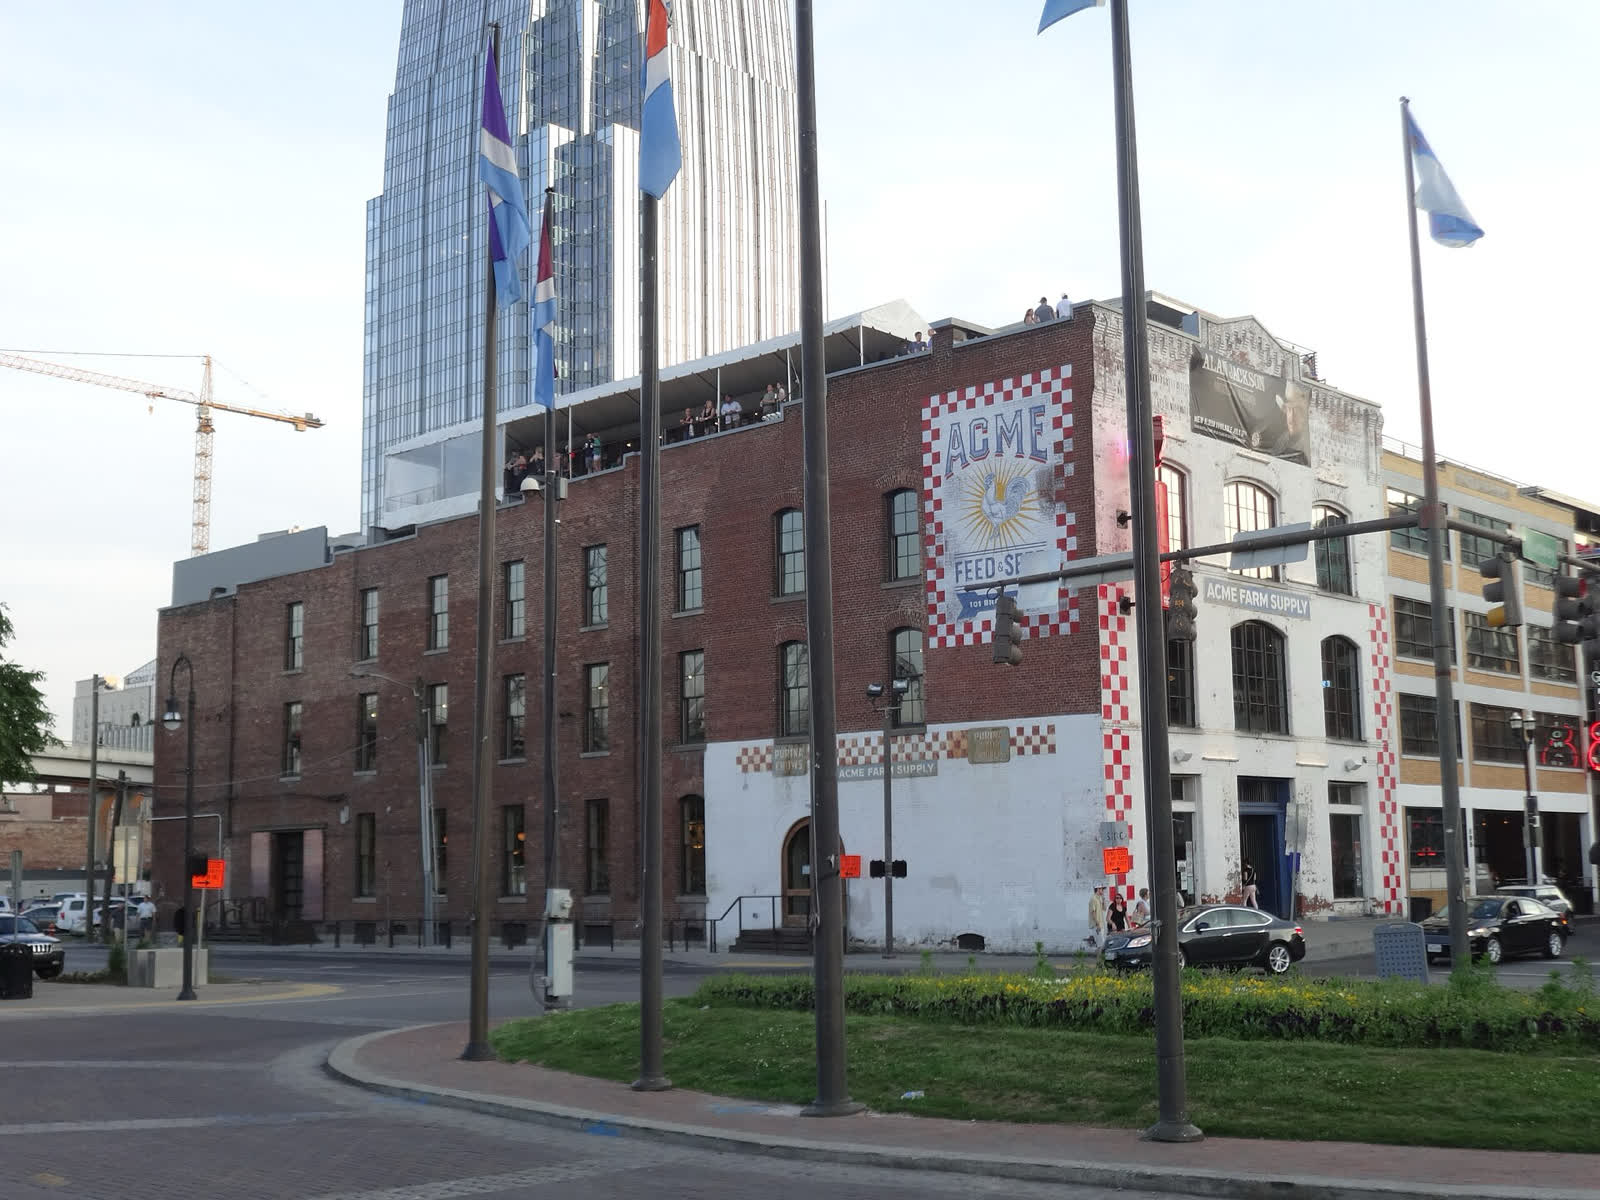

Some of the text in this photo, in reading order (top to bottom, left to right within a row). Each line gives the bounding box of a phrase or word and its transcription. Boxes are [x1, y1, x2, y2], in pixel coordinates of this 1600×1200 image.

[1229, 364, 1265, 392] JACKSON
[945, 405, 1048, 479] ACME
[955, 556, 996, 584] FEED
[1207, 582, 1308, 615] ACME FARM SUPPLY
[839, 768, 865, 778] ACME
[897, 763, 934, 775] SUPPLY
